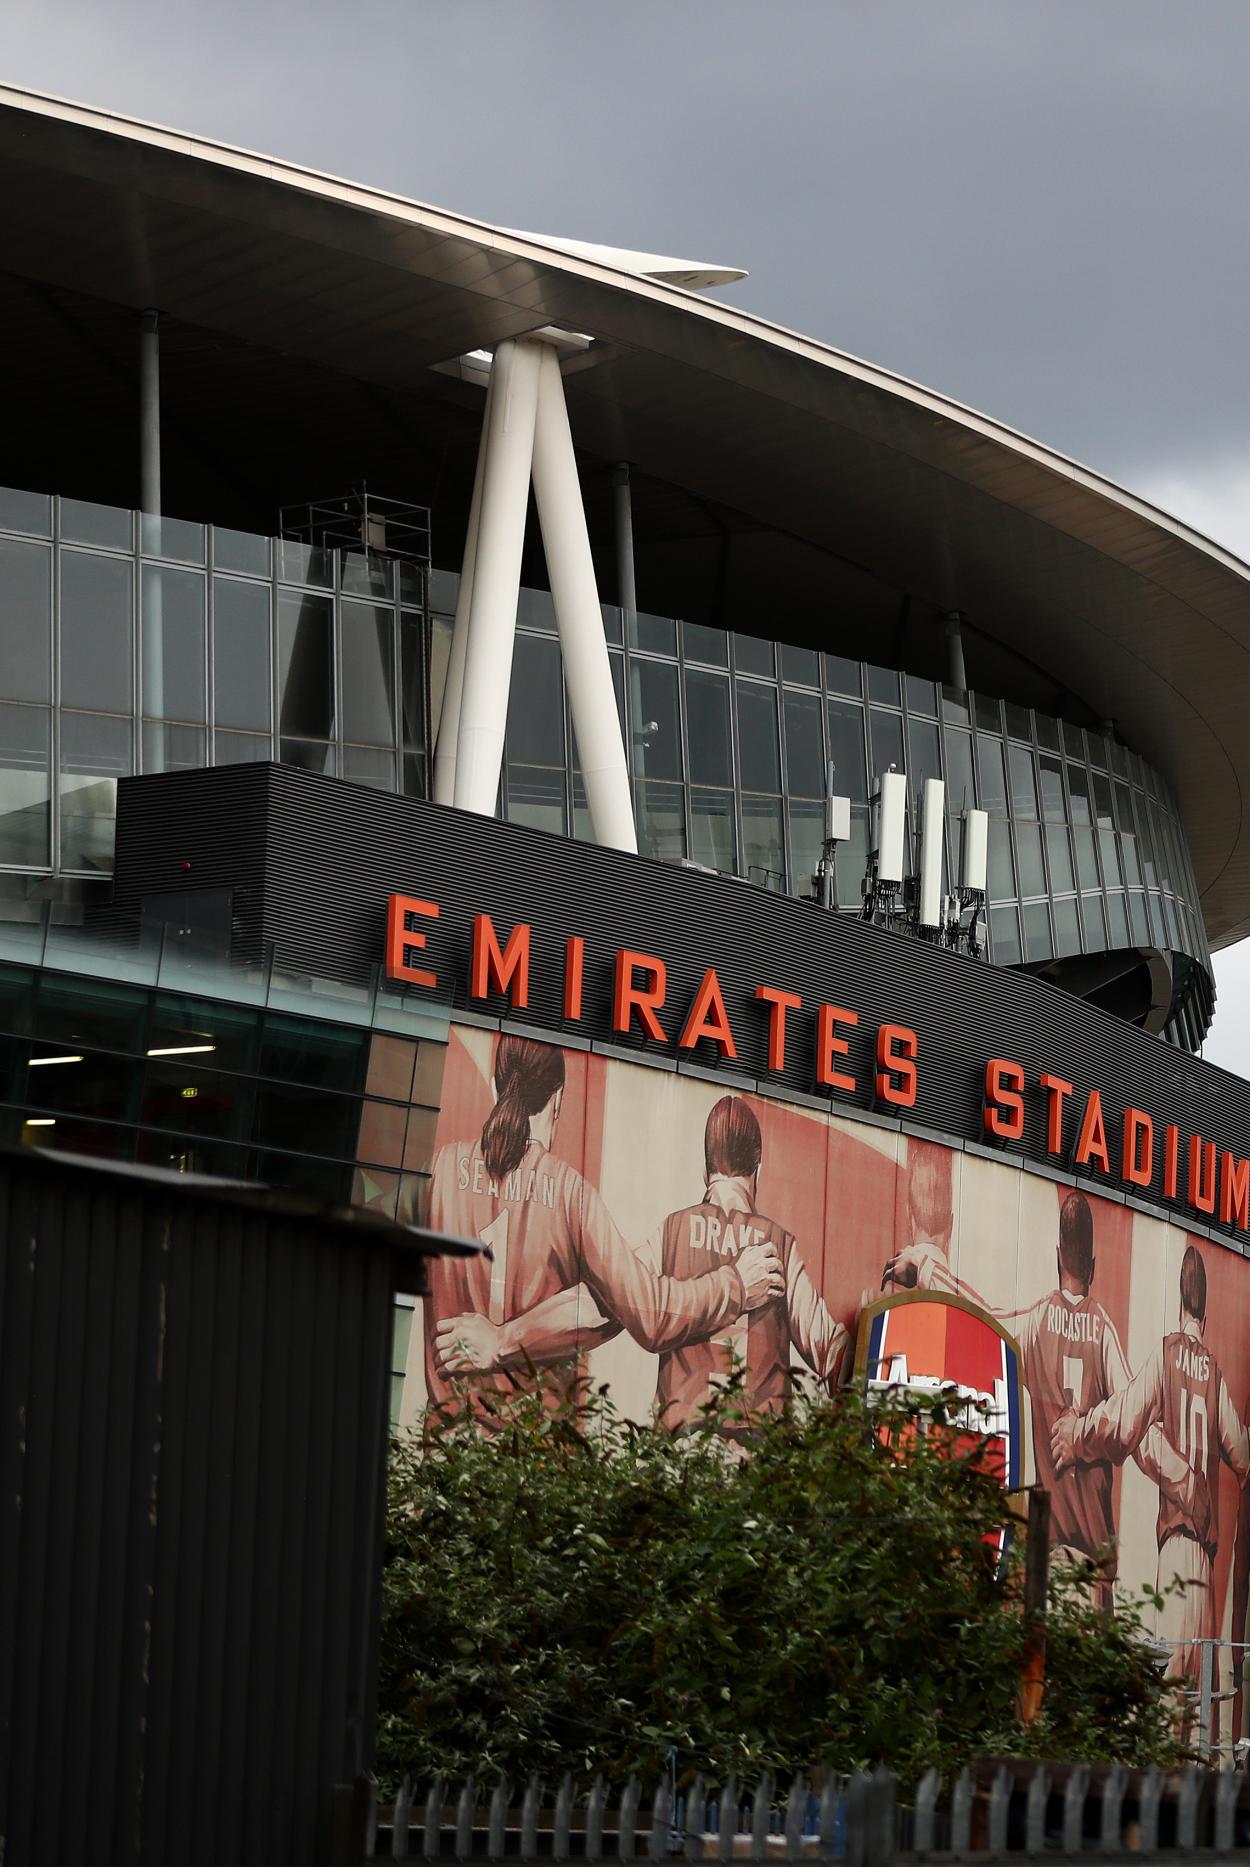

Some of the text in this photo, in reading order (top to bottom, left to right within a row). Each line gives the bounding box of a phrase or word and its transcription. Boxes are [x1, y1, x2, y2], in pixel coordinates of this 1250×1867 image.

[386, 894, 1250, 1231] EMIRATES STADIUM
[457, 1156, 555, 1209] SEAMAN
[1047, 1303, 1100, 1345] ROCASTLE
[1063, 1355, 1084, 1408] 7
[1175, 1344, 1210, 1382] JAMES
[888, 1353, 1010, 1438] Aenal
[1179, 1387, 1208, 1498] 10
